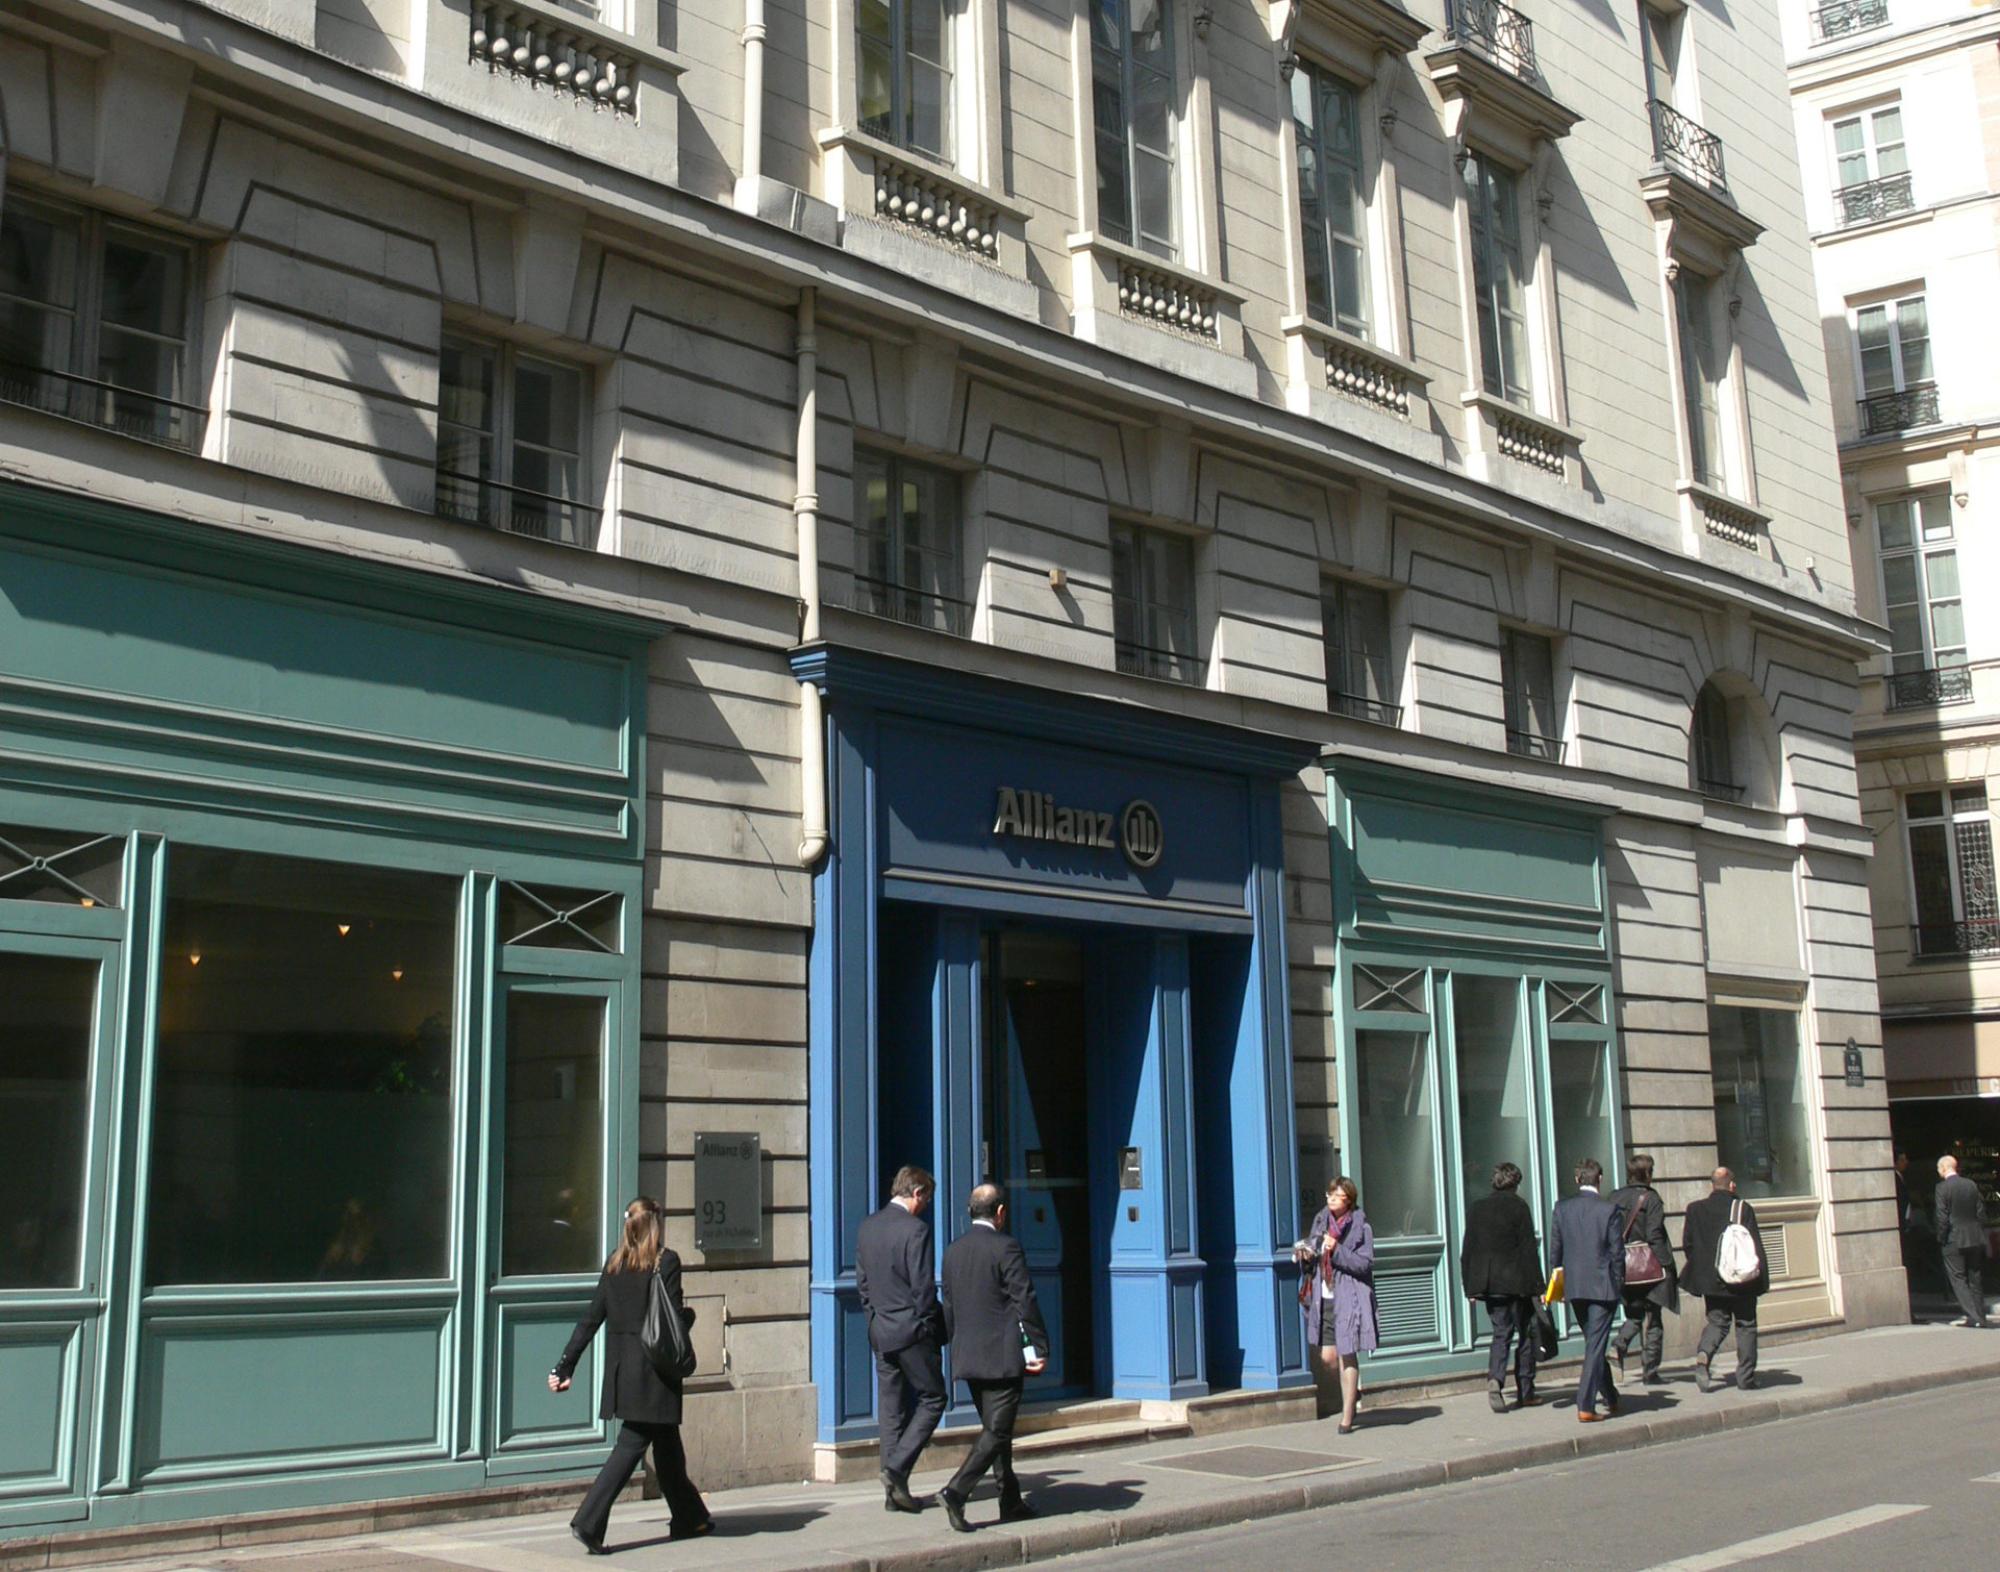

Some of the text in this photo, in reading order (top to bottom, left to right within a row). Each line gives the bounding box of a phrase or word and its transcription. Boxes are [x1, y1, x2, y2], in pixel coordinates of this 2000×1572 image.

[993, 786, 1117, 849] Allianz
[703, 1143, 738, 1157] Allianz
[703, 1200, 726, 1225] 93
